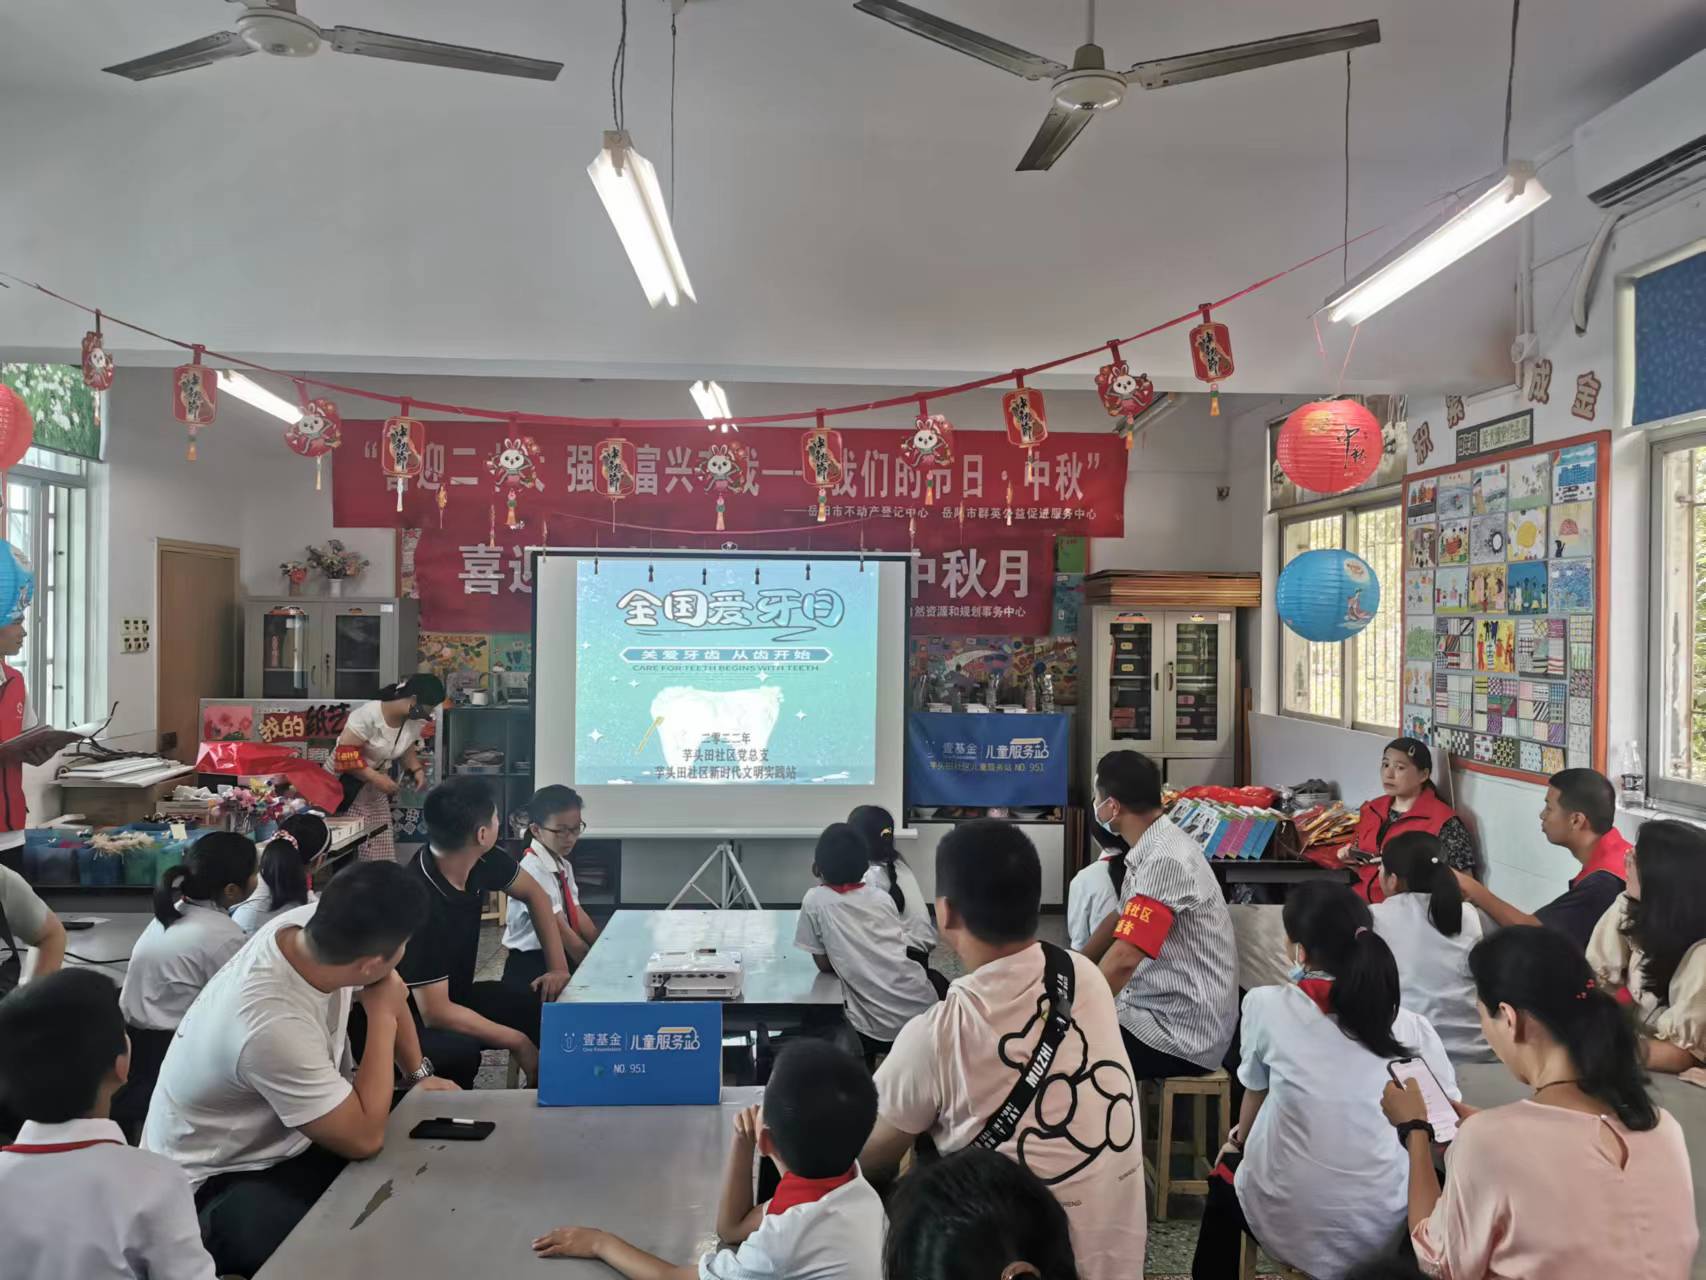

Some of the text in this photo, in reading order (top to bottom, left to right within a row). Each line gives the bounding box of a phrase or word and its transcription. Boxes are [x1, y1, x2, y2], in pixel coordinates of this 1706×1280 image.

[616, 588, 846, 628] 全国爱牙日
[910, 605, 1027, 619] 然资源和规划事务中心
[632, 664, 659, 673] CARE
[661, 664, 681, 673] FOR
[682, 749, 769, 762] 芋头田社区党总支
[985, 741, 1049, 760] 儿童服务站
[654, 765, 797, 779] 芋头田社区新时代文明实践站
[582, 1031, 701, 1051] 壹基金 儿童服务站
[629, 1063, 647, 1074] 951
[1025, 1041, 1054, 1088] MUZHI
